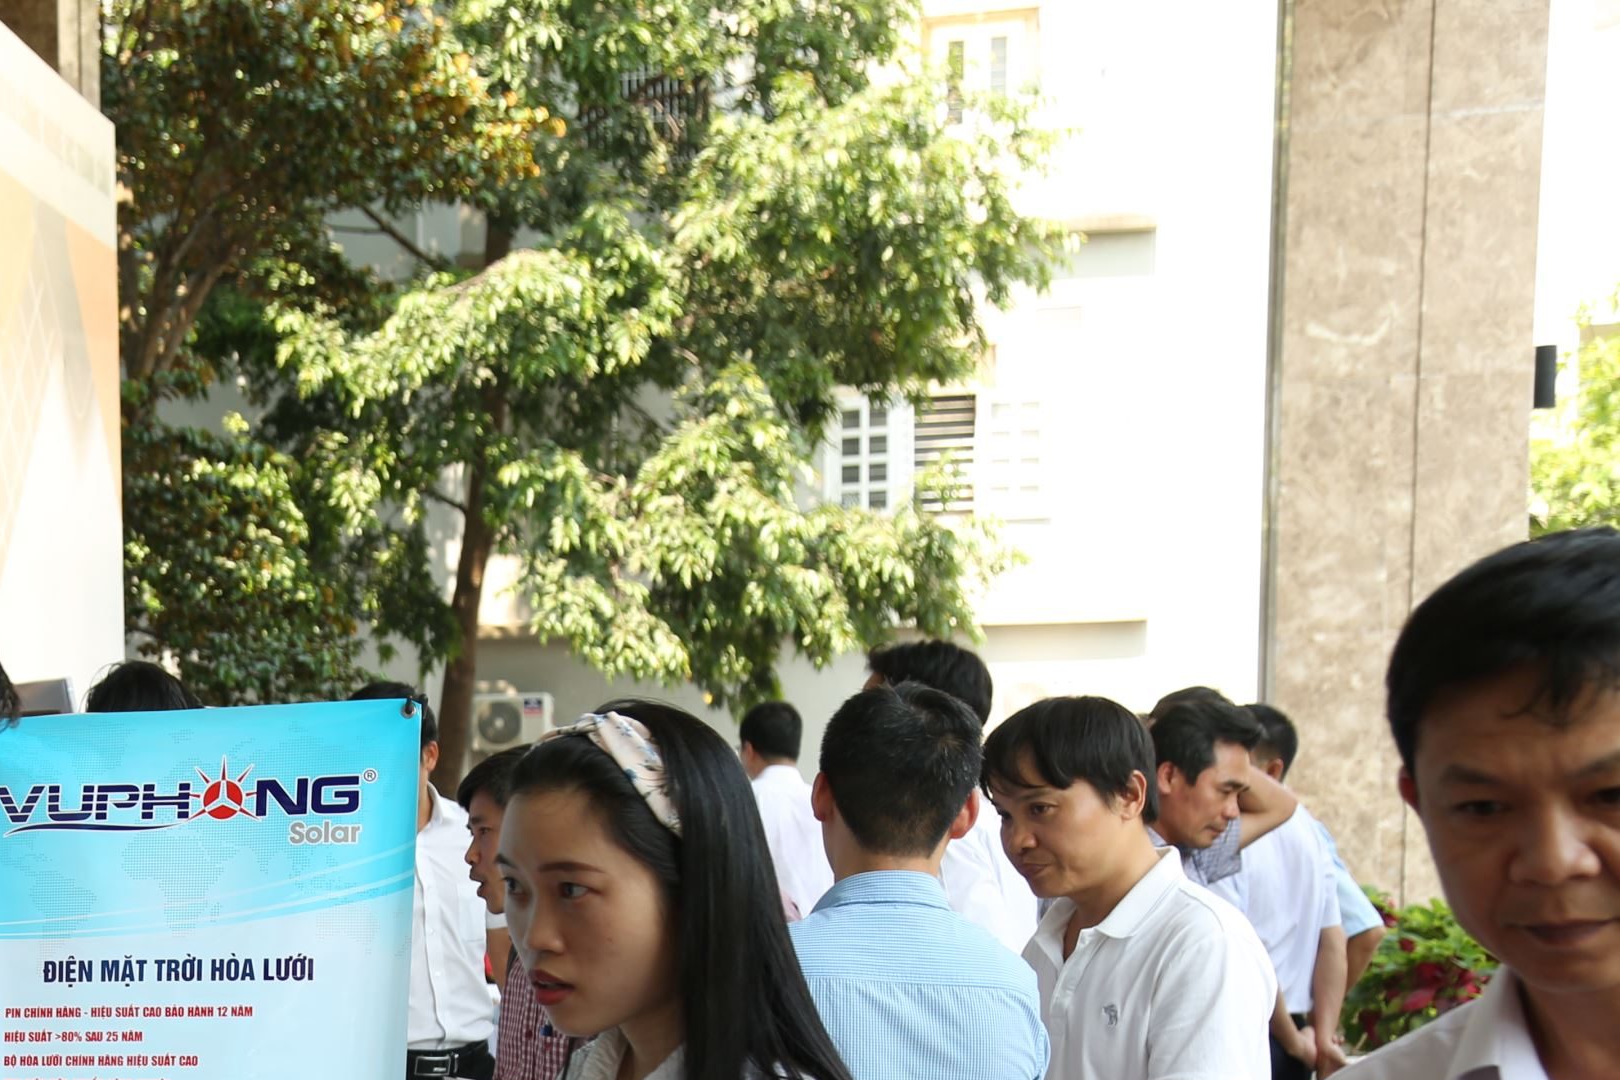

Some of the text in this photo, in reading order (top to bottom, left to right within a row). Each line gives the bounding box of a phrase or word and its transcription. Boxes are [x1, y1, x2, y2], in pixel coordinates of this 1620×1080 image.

[289, 820, 362, 846] Solar
[43, 952, 314, 988] ĐIỆN MẶT TRỜI HÒA LƯỚI
[5, 1007, 22, 1018] PIN
[143, 1006, 162, 1018] CAO
[217, 1006, 228, 1017] 12
[54, 1031, 82, 1043] >80%
[85, 1031, 103, 1042] SAU
[106, 1031, 118, 1042] 25
[179, 1055, 198, 1066] CAO
